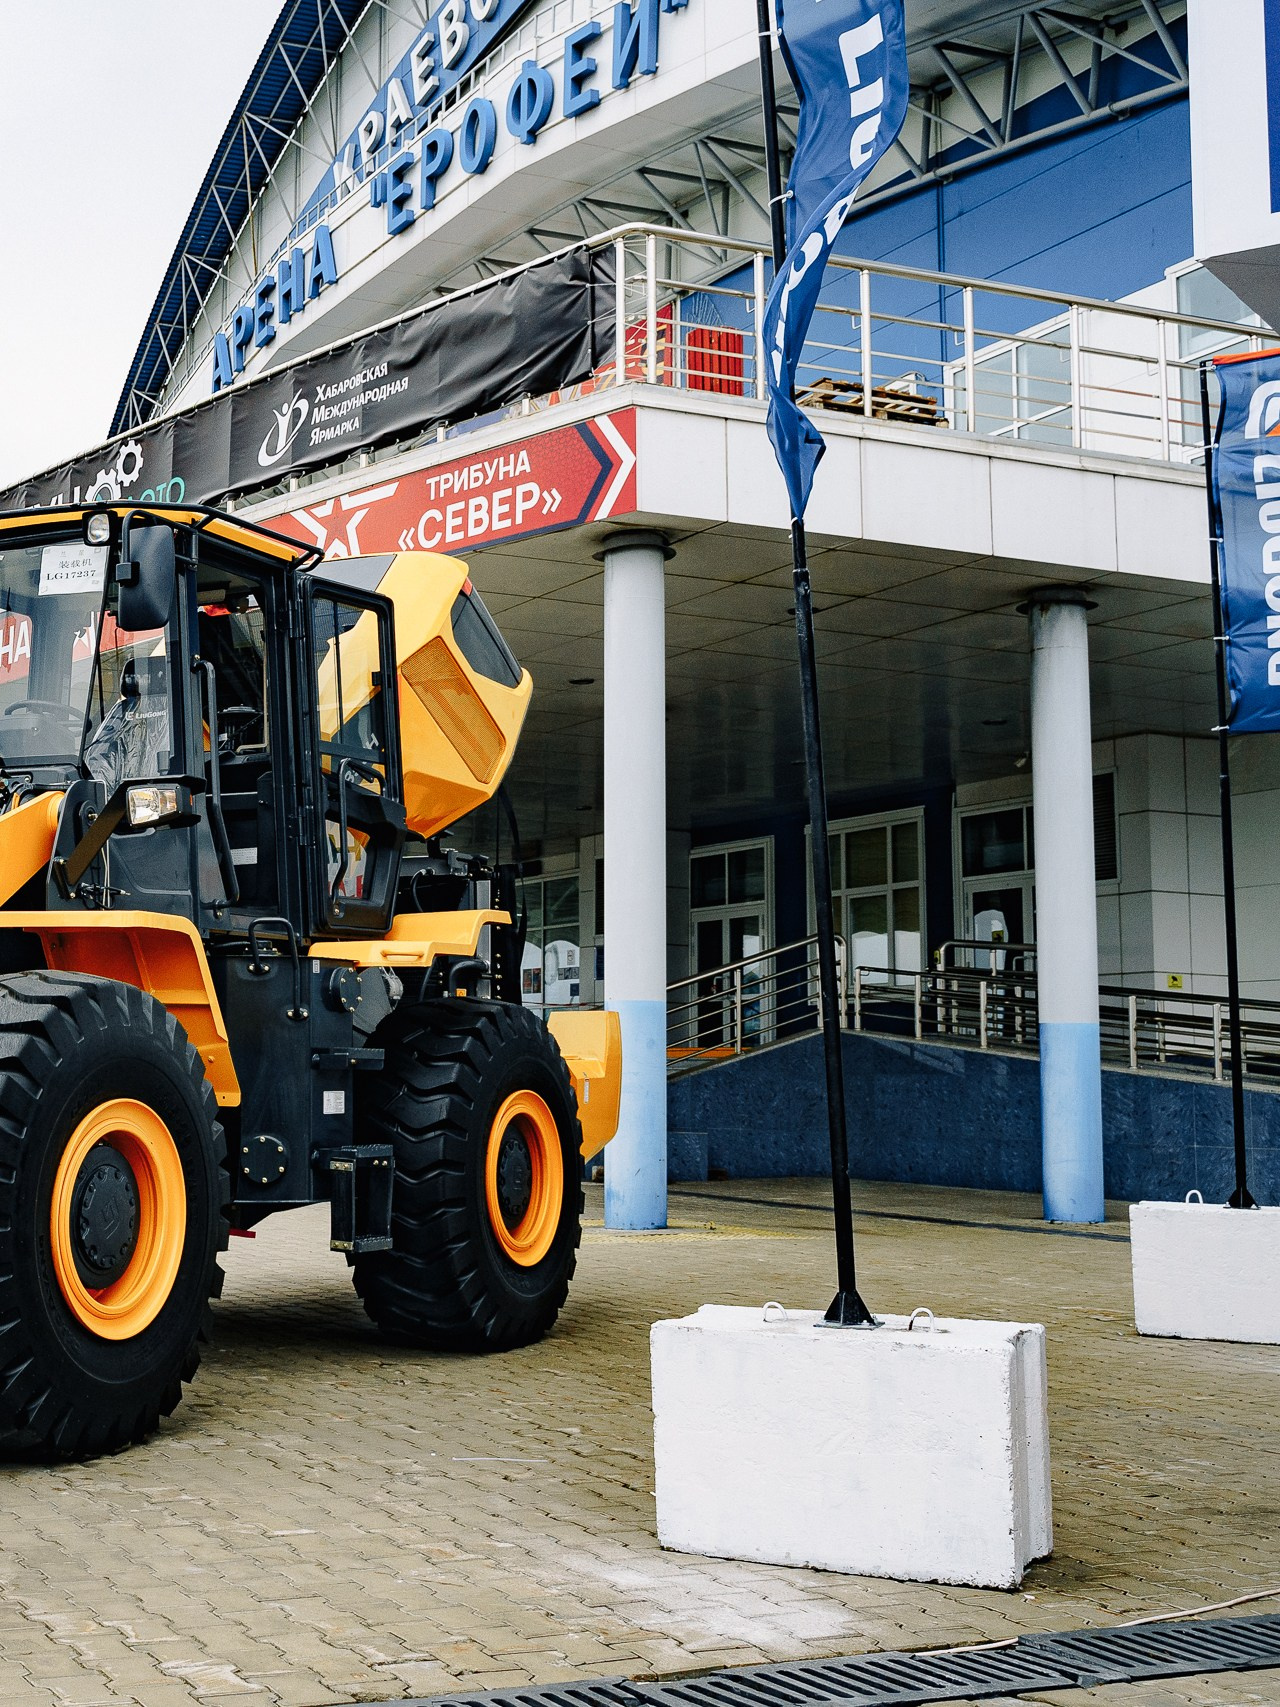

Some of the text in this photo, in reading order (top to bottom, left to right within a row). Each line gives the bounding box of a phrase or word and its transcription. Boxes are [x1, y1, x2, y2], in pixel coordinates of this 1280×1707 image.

[212, 225, 338, 394] АРЕНА
[426, 450, 531, 500] ТРИБУНА
[398, 481, 563, 551] «СЕВЕР»
[46, 570, 97, 581] LG17237
